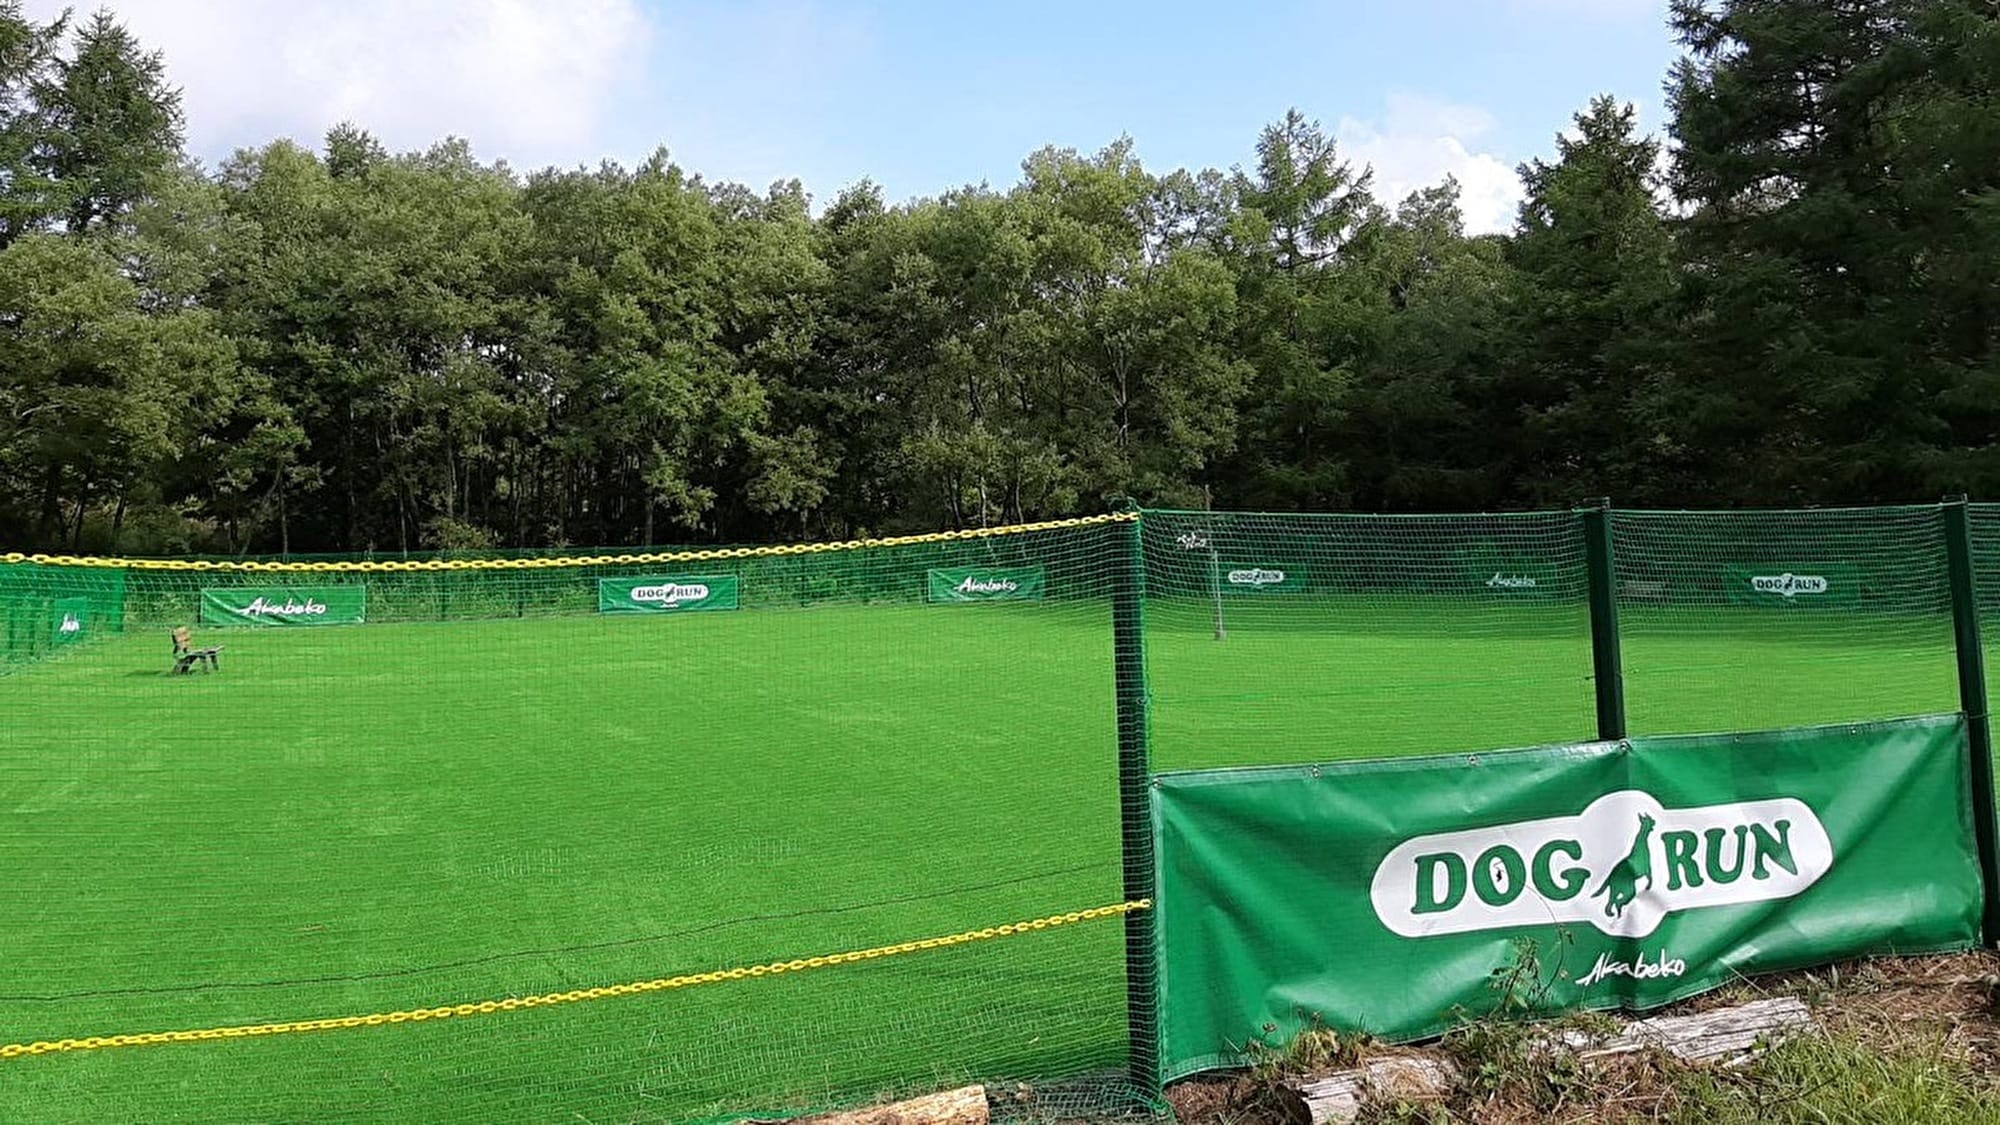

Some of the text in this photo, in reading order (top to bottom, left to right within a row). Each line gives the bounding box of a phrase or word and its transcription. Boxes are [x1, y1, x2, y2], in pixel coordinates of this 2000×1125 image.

[637, 586, 702, 598] DOG RUN
[1756, 579, 1820, 589] DOG RUN
[1411, 819, 1798, 914] DOG RUN
[1575, 948, 1685, 986] Akabeko
